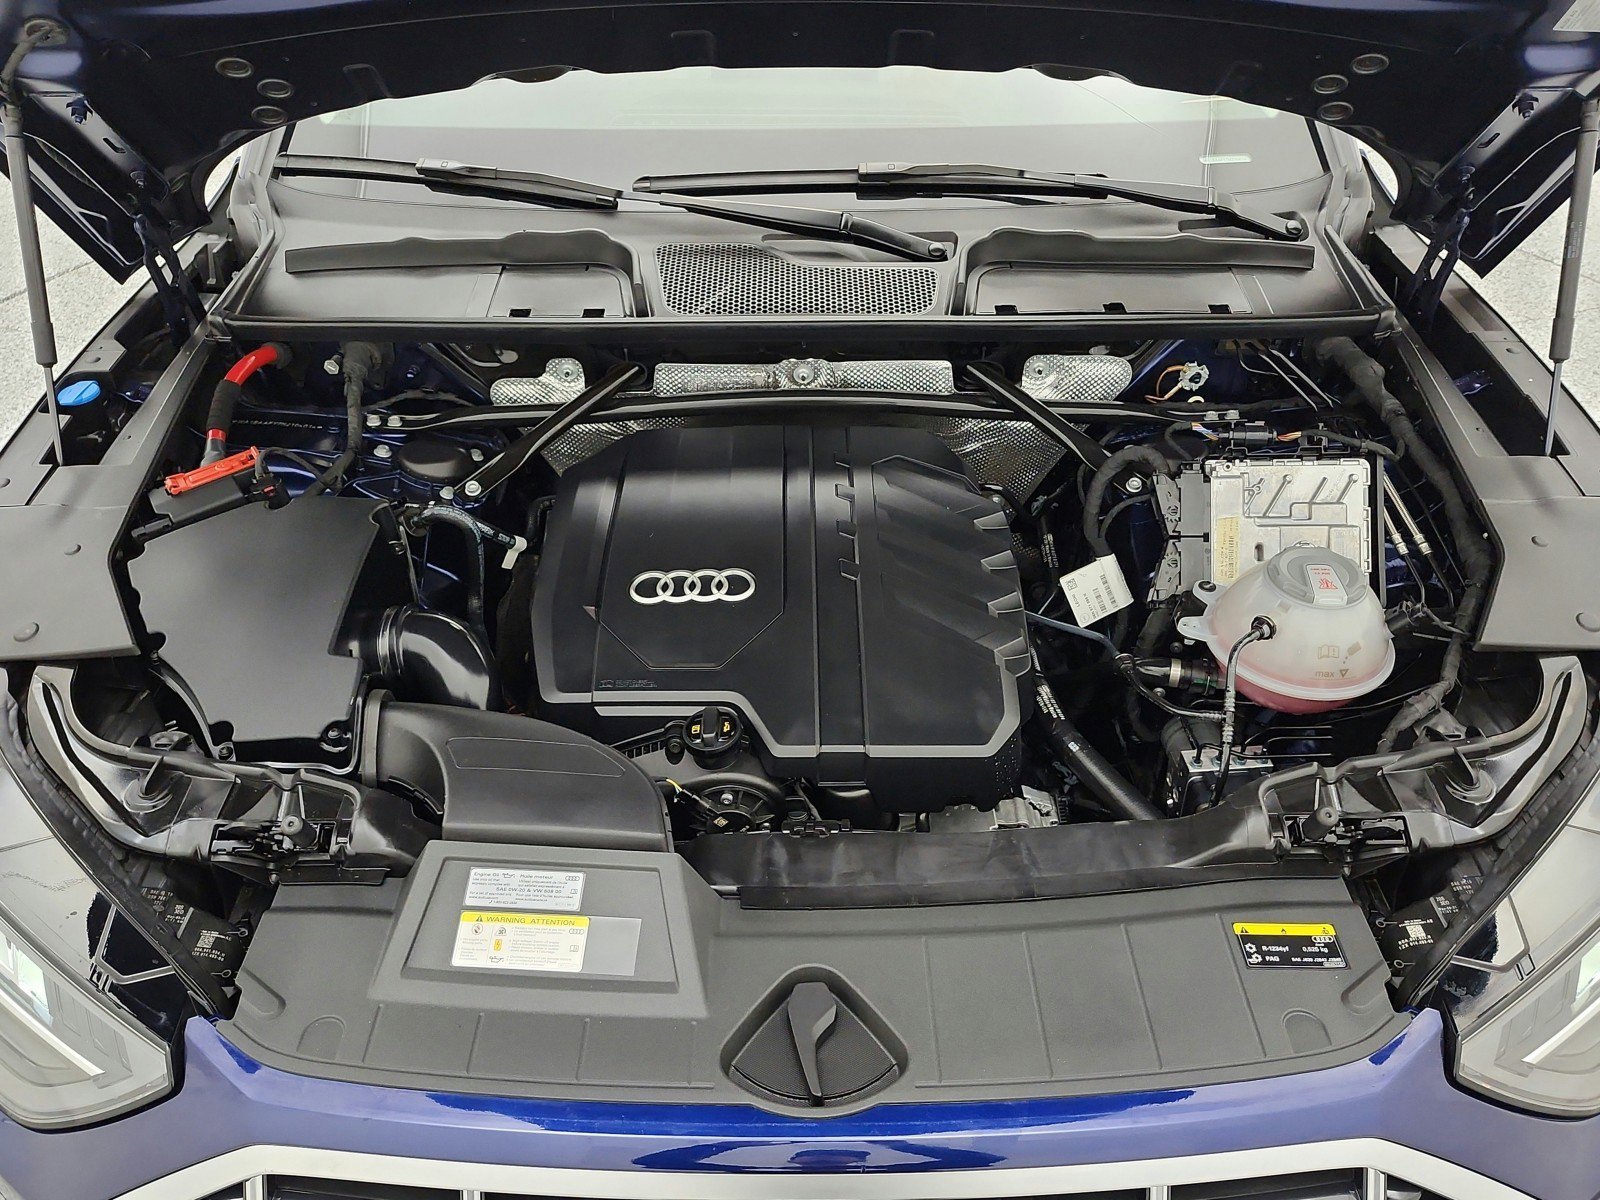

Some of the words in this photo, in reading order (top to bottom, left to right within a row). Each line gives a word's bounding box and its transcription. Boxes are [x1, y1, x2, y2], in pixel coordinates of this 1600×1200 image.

[1315, 670, 1335, 678] max
[486, 916, 526, 924] WARNING
[530, 918, 576, 926] ATTENTION
[1261, 945, 1290, 953] R-1234yf
